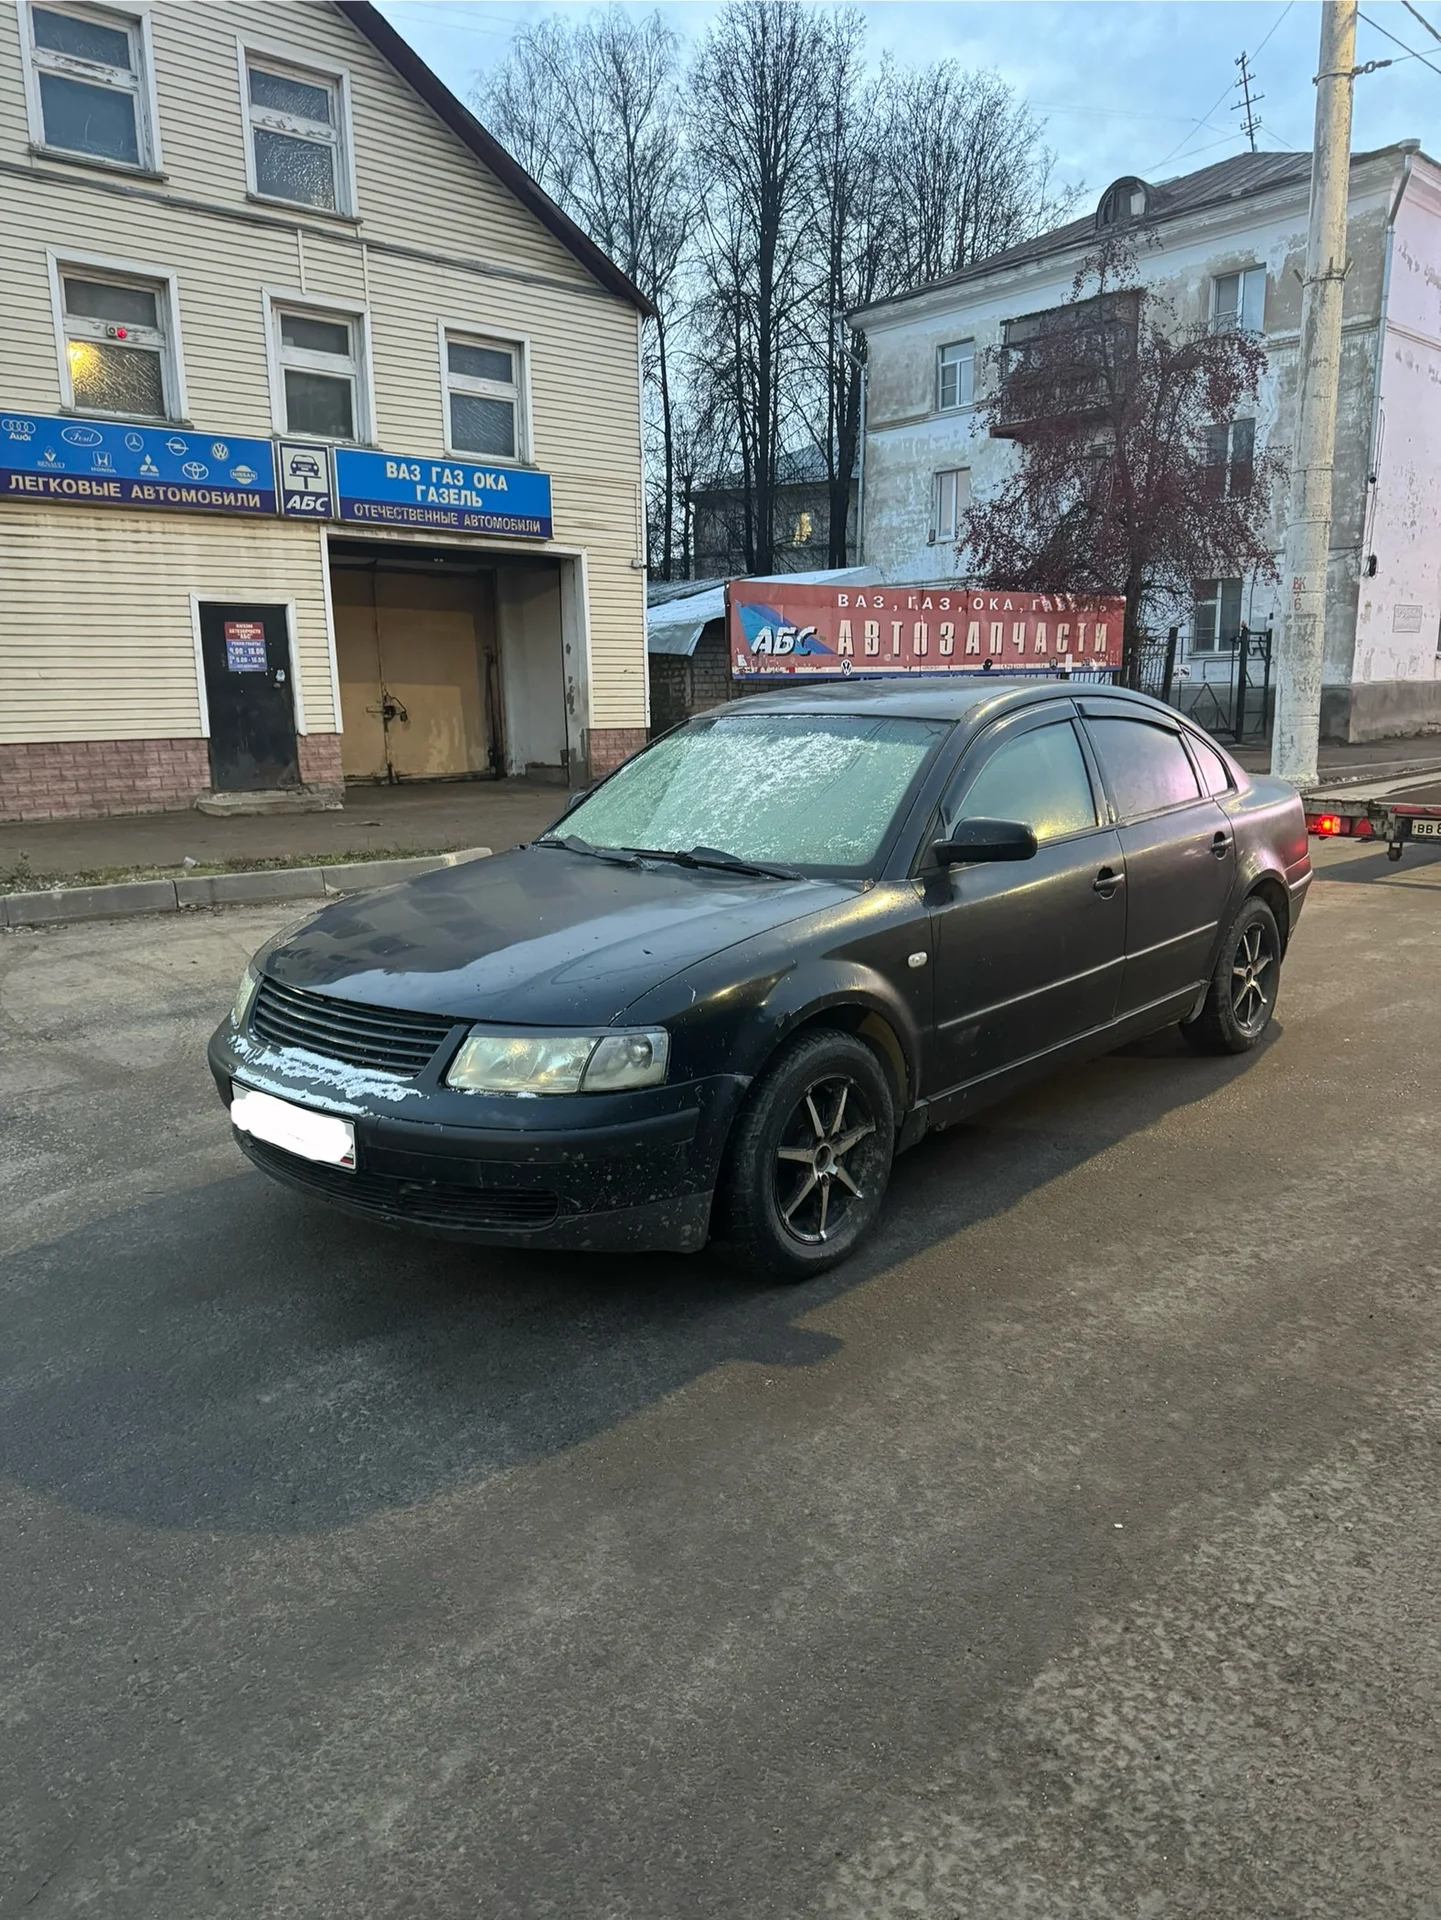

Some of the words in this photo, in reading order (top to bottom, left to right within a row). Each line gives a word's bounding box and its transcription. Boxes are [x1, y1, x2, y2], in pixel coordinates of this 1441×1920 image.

[9, 432, 31, 441] Audi
[231, 470, 256, 479] NISSAN
[386, 461, 421, 482] ВАЗ
[431, 467, 464, 486] ГАЗ
[473, 472, 509, 491] ОКА
[9, 474, 122, 498] ЛЕГКОВЫЕ
[130, 484, 261, 508] АВТОМОБИЛИ
[286, 495, 329, 512] АБС
[415, 485, 483, 508] ГАЗЕЛЬ
[353, 502, 459, 525] ОТЕЧЕСТВЕННЫЕ
[463, 514, 541, 533] АВТОМОБИЛИ
[837, 593, 898, 612] ВАЗ,
[907, 596, 963, 612] ГАЗ,
[972, 597, 1024, 613] ОКА,
[751, 626, 818, 657] АБС
[837, 619, 1108, 657] АВТОЗАПЧАСТИ
